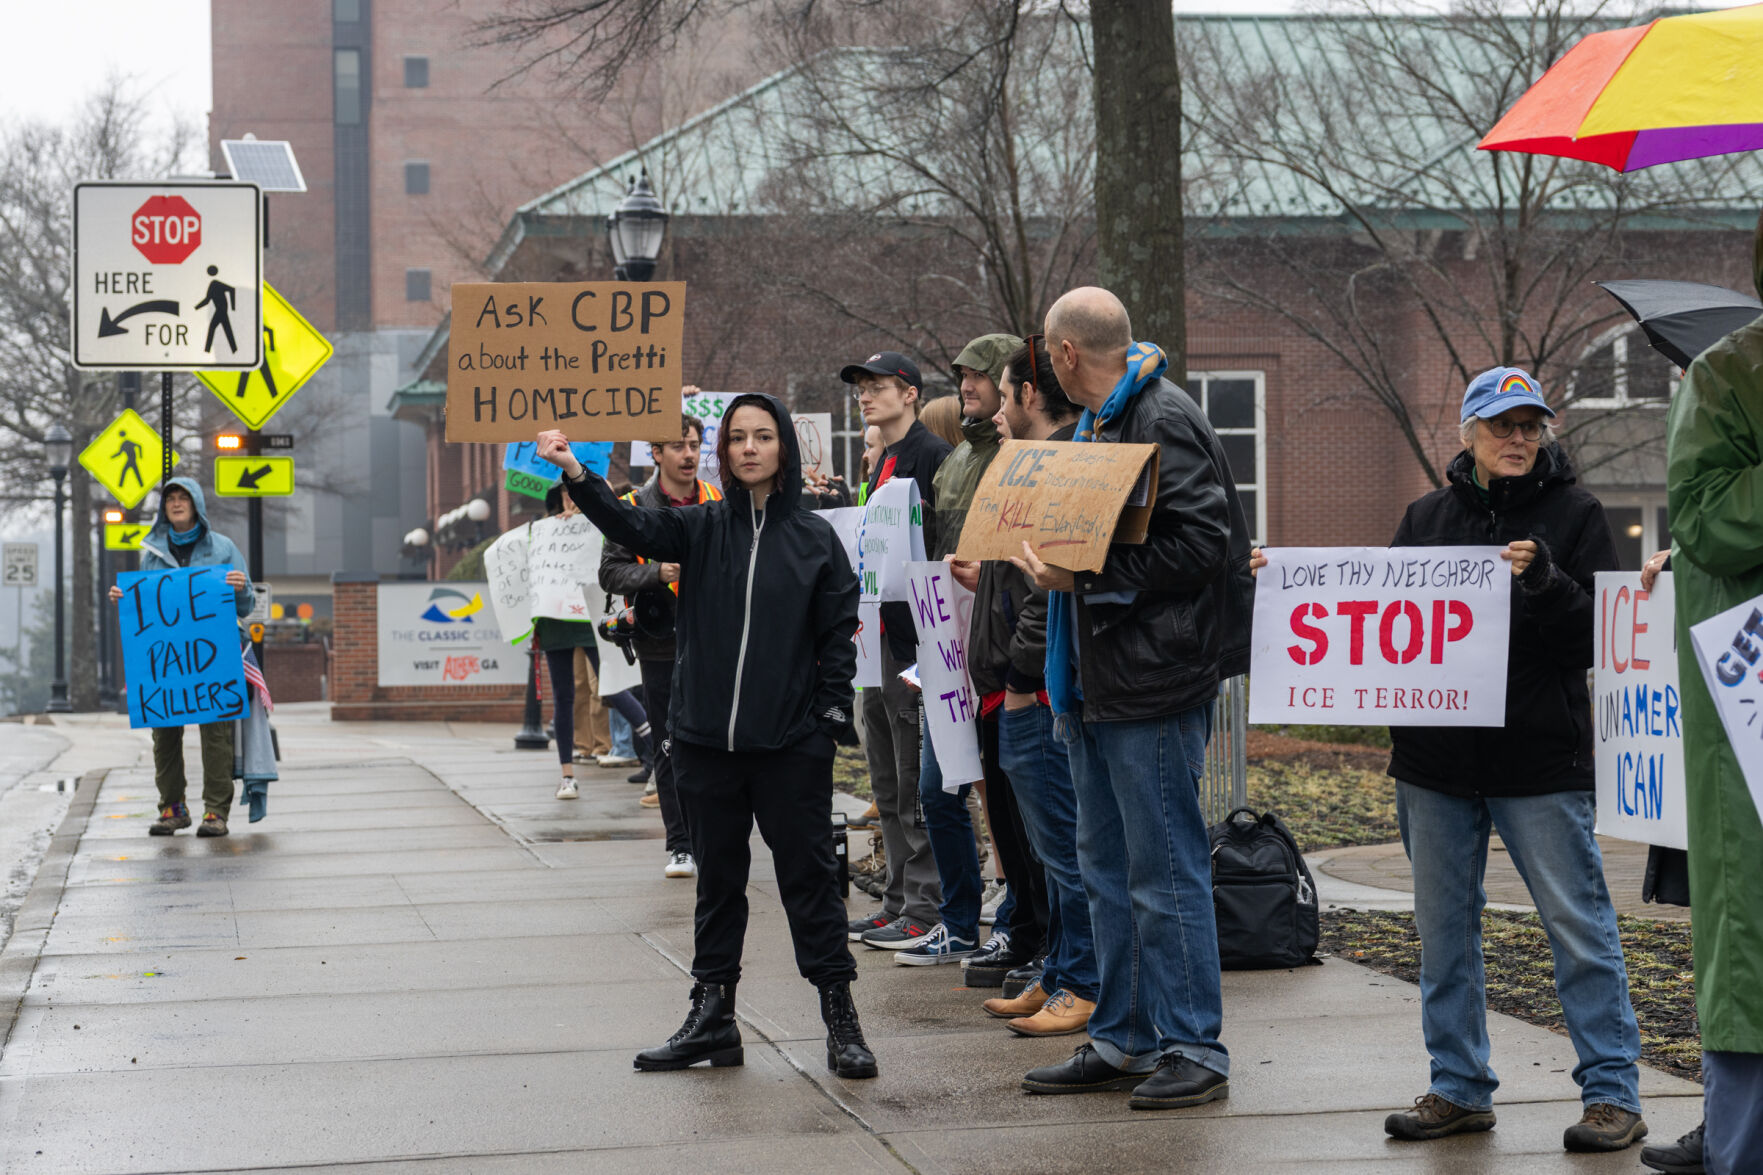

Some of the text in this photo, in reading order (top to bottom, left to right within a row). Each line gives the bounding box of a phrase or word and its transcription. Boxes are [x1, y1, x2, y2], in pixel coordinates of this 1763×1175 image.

[133, 215, 200, 245] STOP
[94, 272, 154, 294] HERE
[571, 290, 671, 334] CBP
[144, 324, 189, 346] FOR
[458, 339, 666, 374] about the Pretti
[473, 386, 663, 423] HOMICIDE
[510, 472, 543, 492] GOOD
[998, 448, 1059, 488] ICE
[997, 496, 1034, 533] KILL
[7, 564, 34, 581] 25
[859, 562, 879, 596] EVIL
[1282, 559, 1496, 591] LOVE THY NEIGHBOR
[127, 569, 217, 637] ICE
[911, 575, 950, 629] WE
[391, 630, 414, 642] THE
[417, 630, 470, 641] CLASSIC
[1286, 600, 1474, 666] STOP
[1601, 585, 1650, 674] ICE
[147, 637, 217, 684] PAID
[413, 660, 440, 670] VISIT
[481, 659, 499, 670] GA
[139, 679, 245, 724] KILLERS
[1288, 686, 1470, 711] ICE TERROR!
[1616, 751, 1664, 821] ICAN
